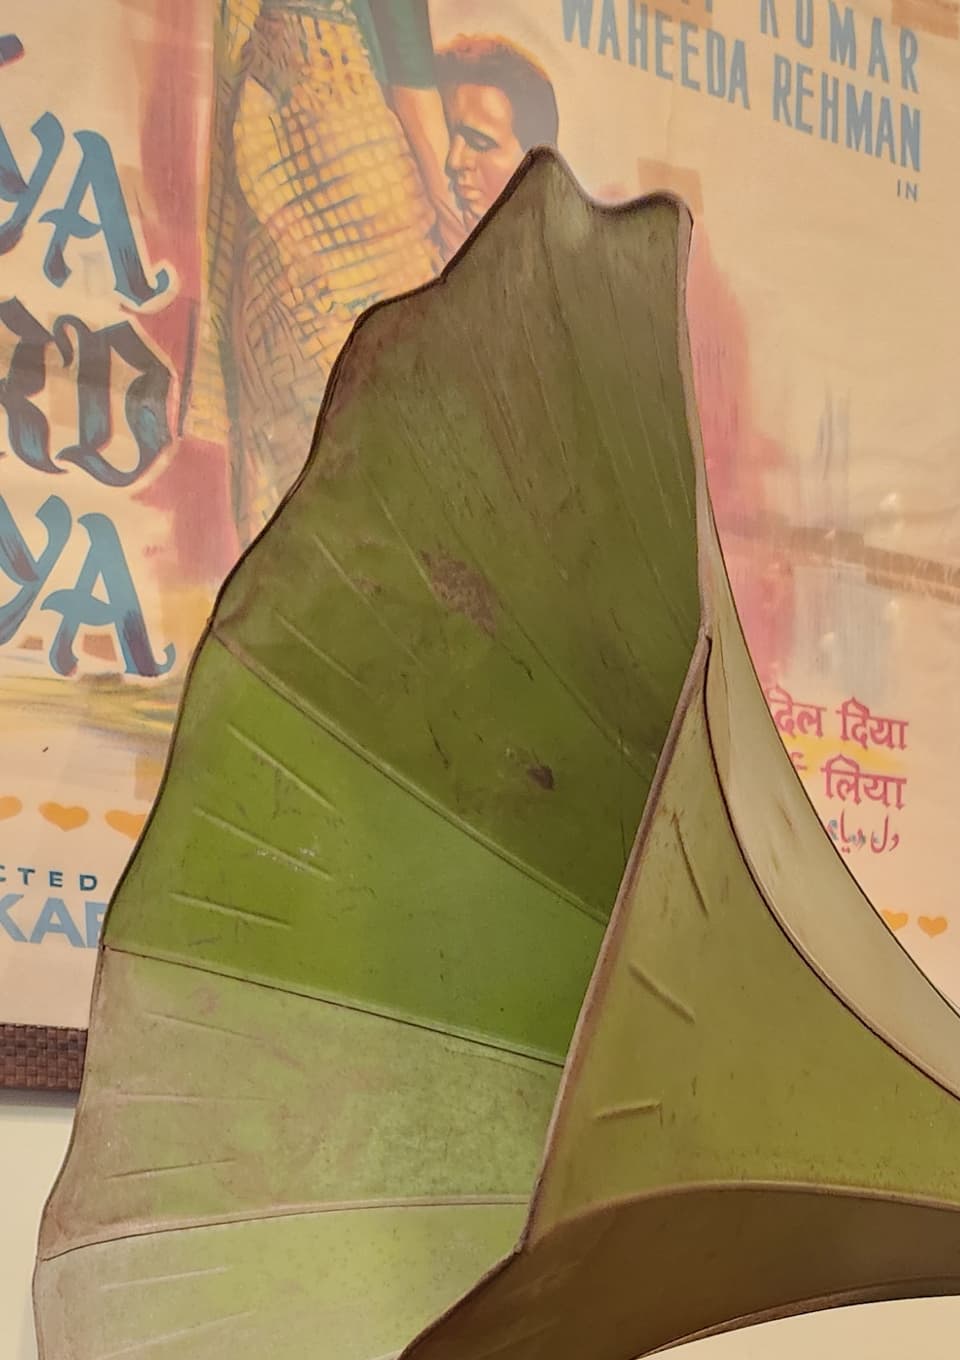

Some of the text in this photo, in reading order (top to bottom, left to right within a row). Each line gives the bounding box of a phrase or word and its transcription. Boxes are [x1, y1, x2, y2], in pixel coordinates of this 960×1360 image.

[561, 0, 921, 172] WAHEEDA REHMAN
[896, 178, 918, 202] IN
[835, 696, 909, 750] दिया
[820, 754, 907, 810] लिया
